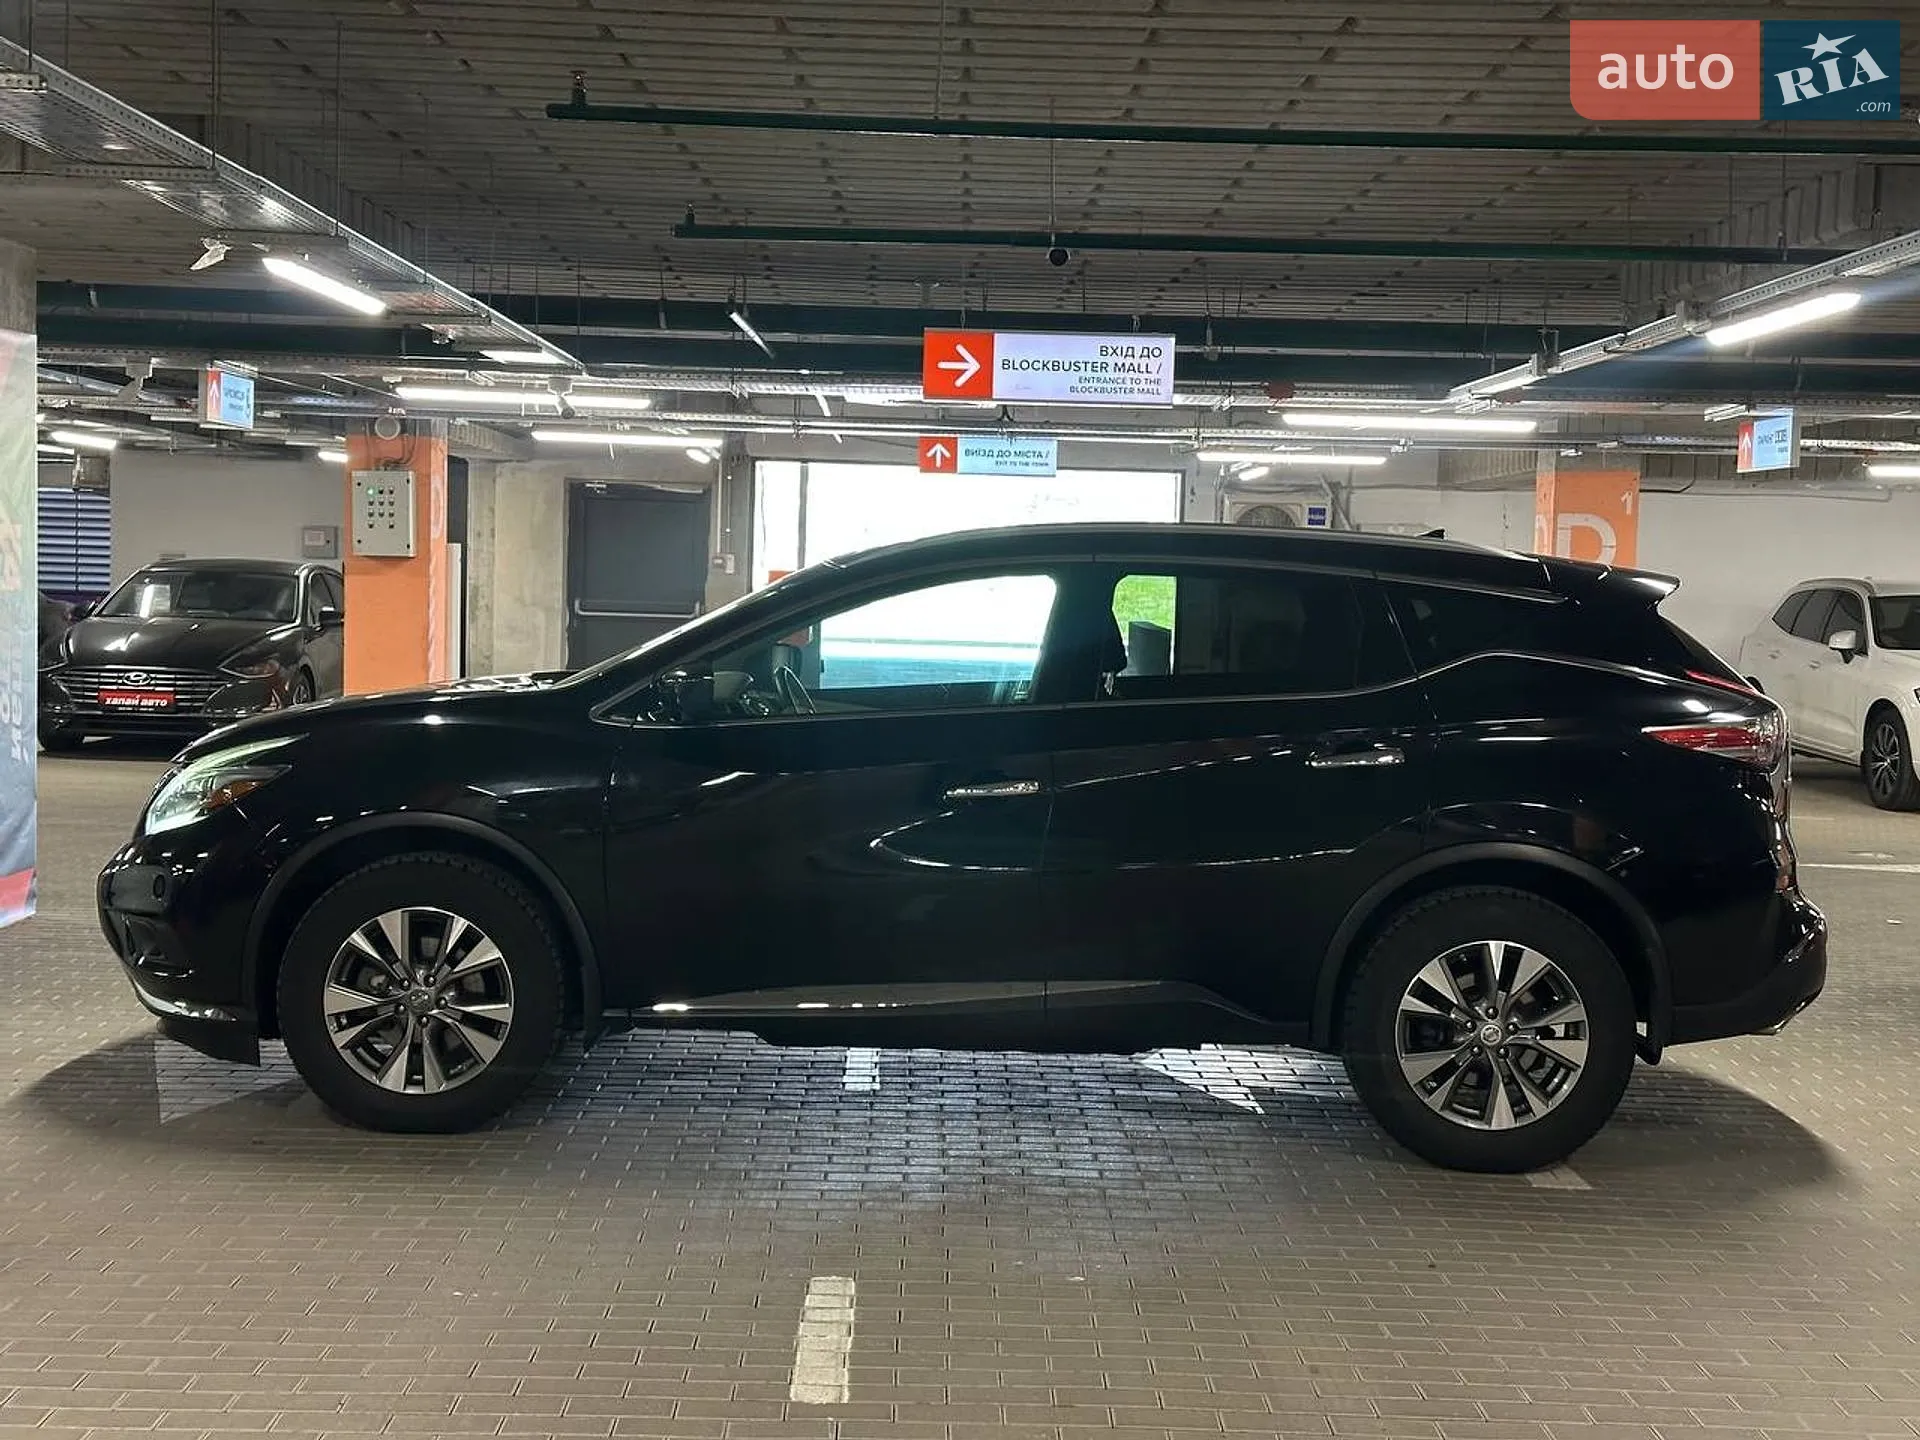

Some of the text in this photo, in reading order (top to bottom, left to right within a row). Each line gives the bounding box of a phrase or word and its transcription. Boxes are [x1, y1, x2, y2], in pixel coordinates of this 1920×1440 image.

[1100, 345, 1163, 359] ВХІД ДО
[1001, 358, 1109, 373] BLOCKBUSTER
[1113, 362, 1152, 374] MALL
[1079, 376, 1161, 385] ENTRANCE TO THE
[1069, 385, 1161, 395] BLOCKBUSTER MALL
[964, 448, 994, 457] ВИЇЗД
[996, 449, 1012, 458] ДО
[1014, 450, 1043, 458] МІСТА
[1620, 491, 1633, 516] 1
